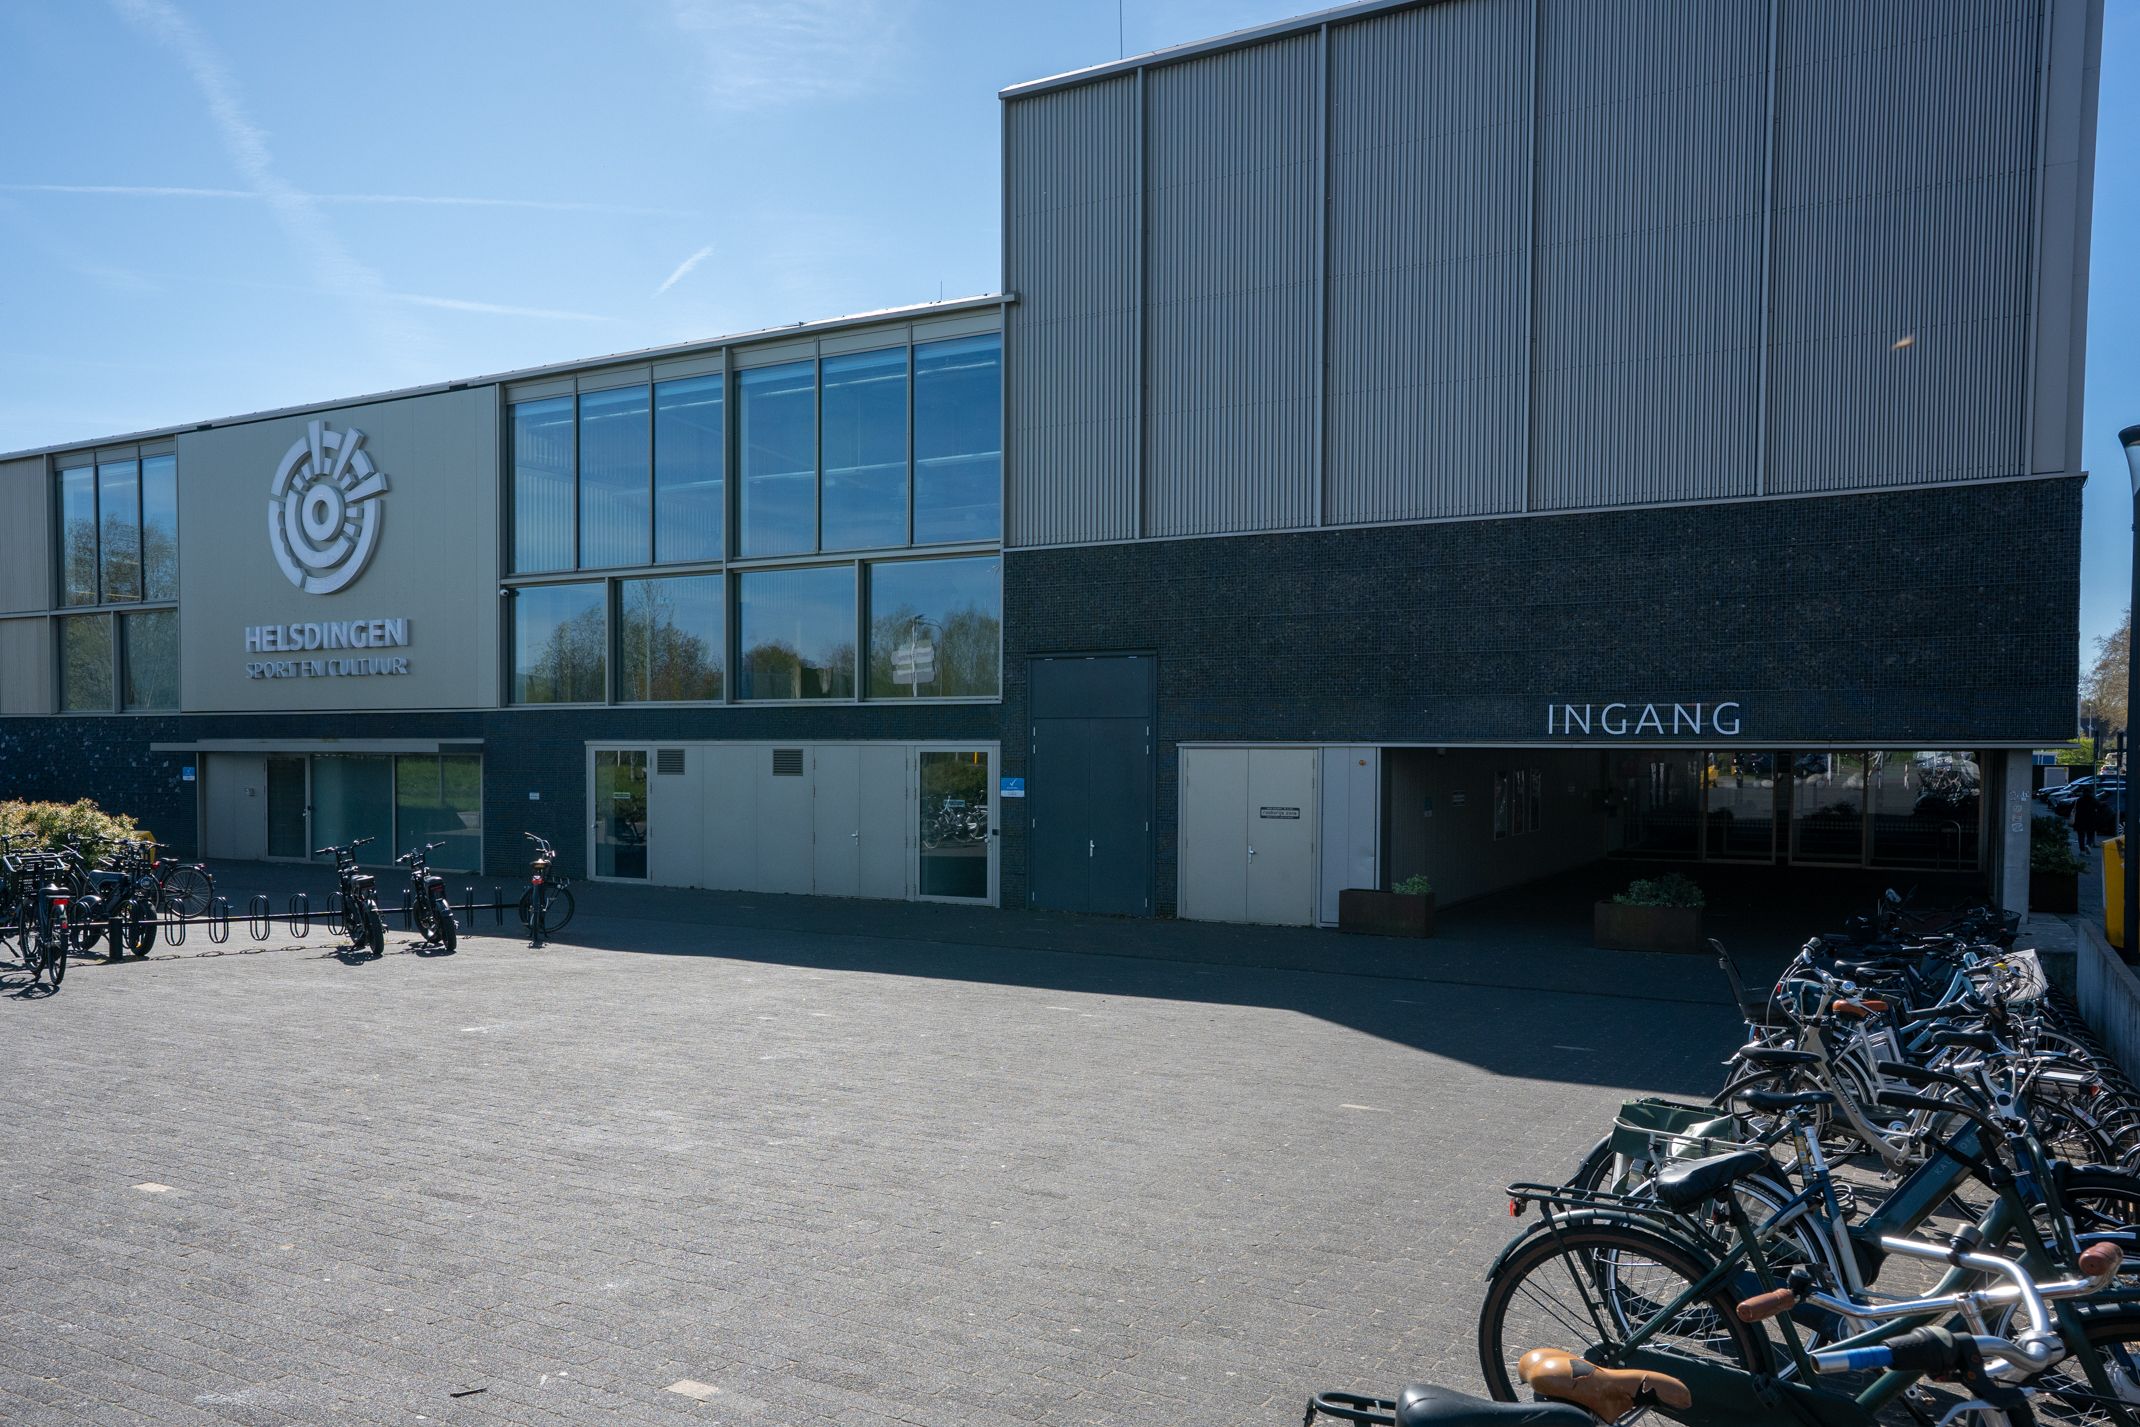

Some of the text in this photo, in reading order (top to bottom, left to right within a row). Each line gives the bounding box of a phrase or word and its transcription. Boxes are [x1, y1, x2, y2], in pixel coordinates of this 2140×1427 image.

[245, 618, 408, 652] HELSDINGEN
[246, 657, 408, 678] SPORT EN CULTUUR
[1549, 702, 1740, 734] INGANG
